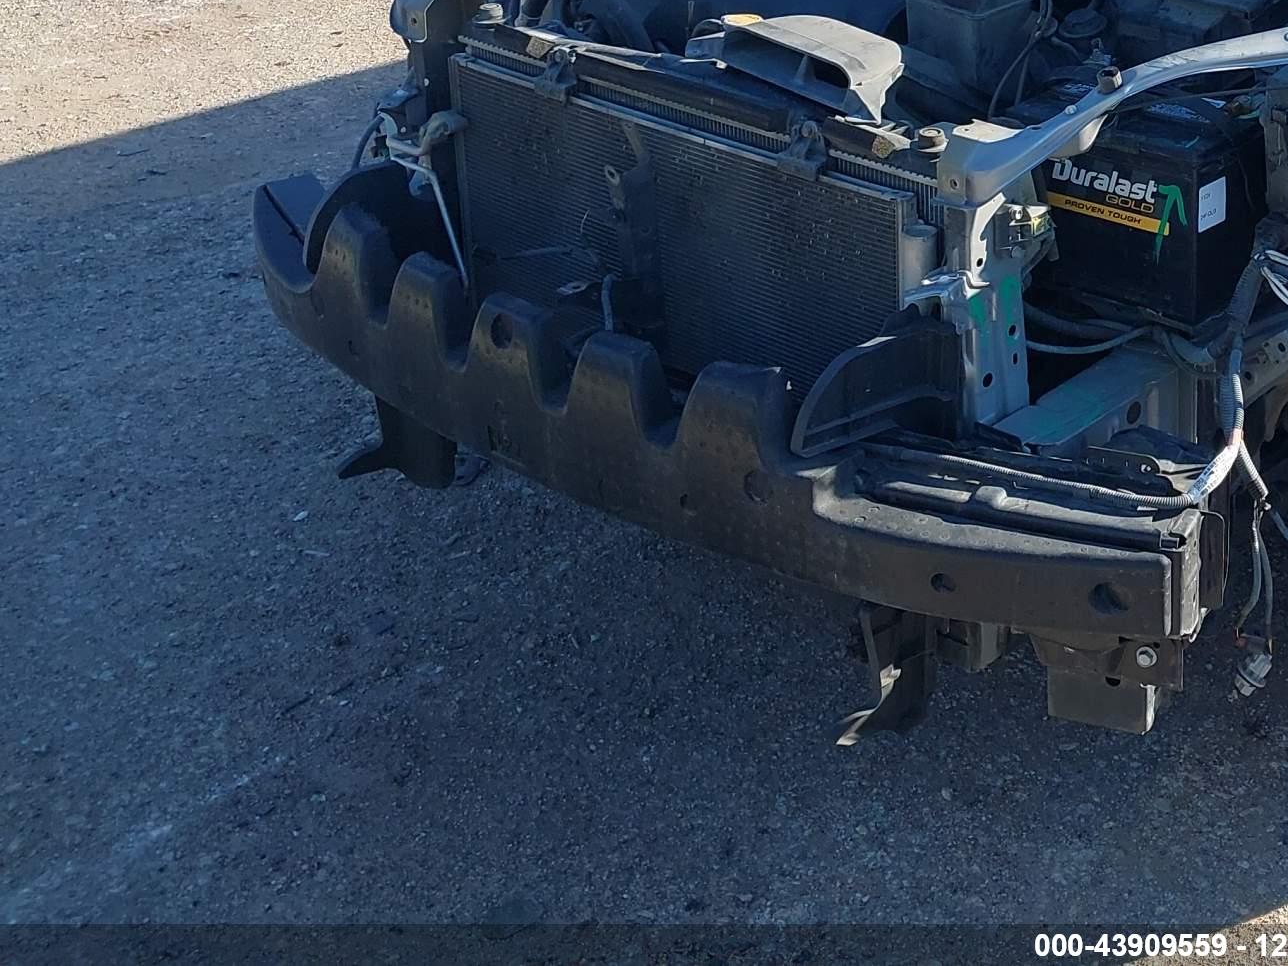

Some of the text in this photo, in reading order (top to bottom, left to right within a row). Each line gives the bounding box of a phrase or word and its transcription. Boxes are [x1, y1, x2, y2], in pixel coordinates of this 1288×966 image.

[1052, 158, 1158, 204] Duralast
[1064, 199, 1142, 225] PROVEN TOUGH
[1105, 194, 1154, 213] GOLD
